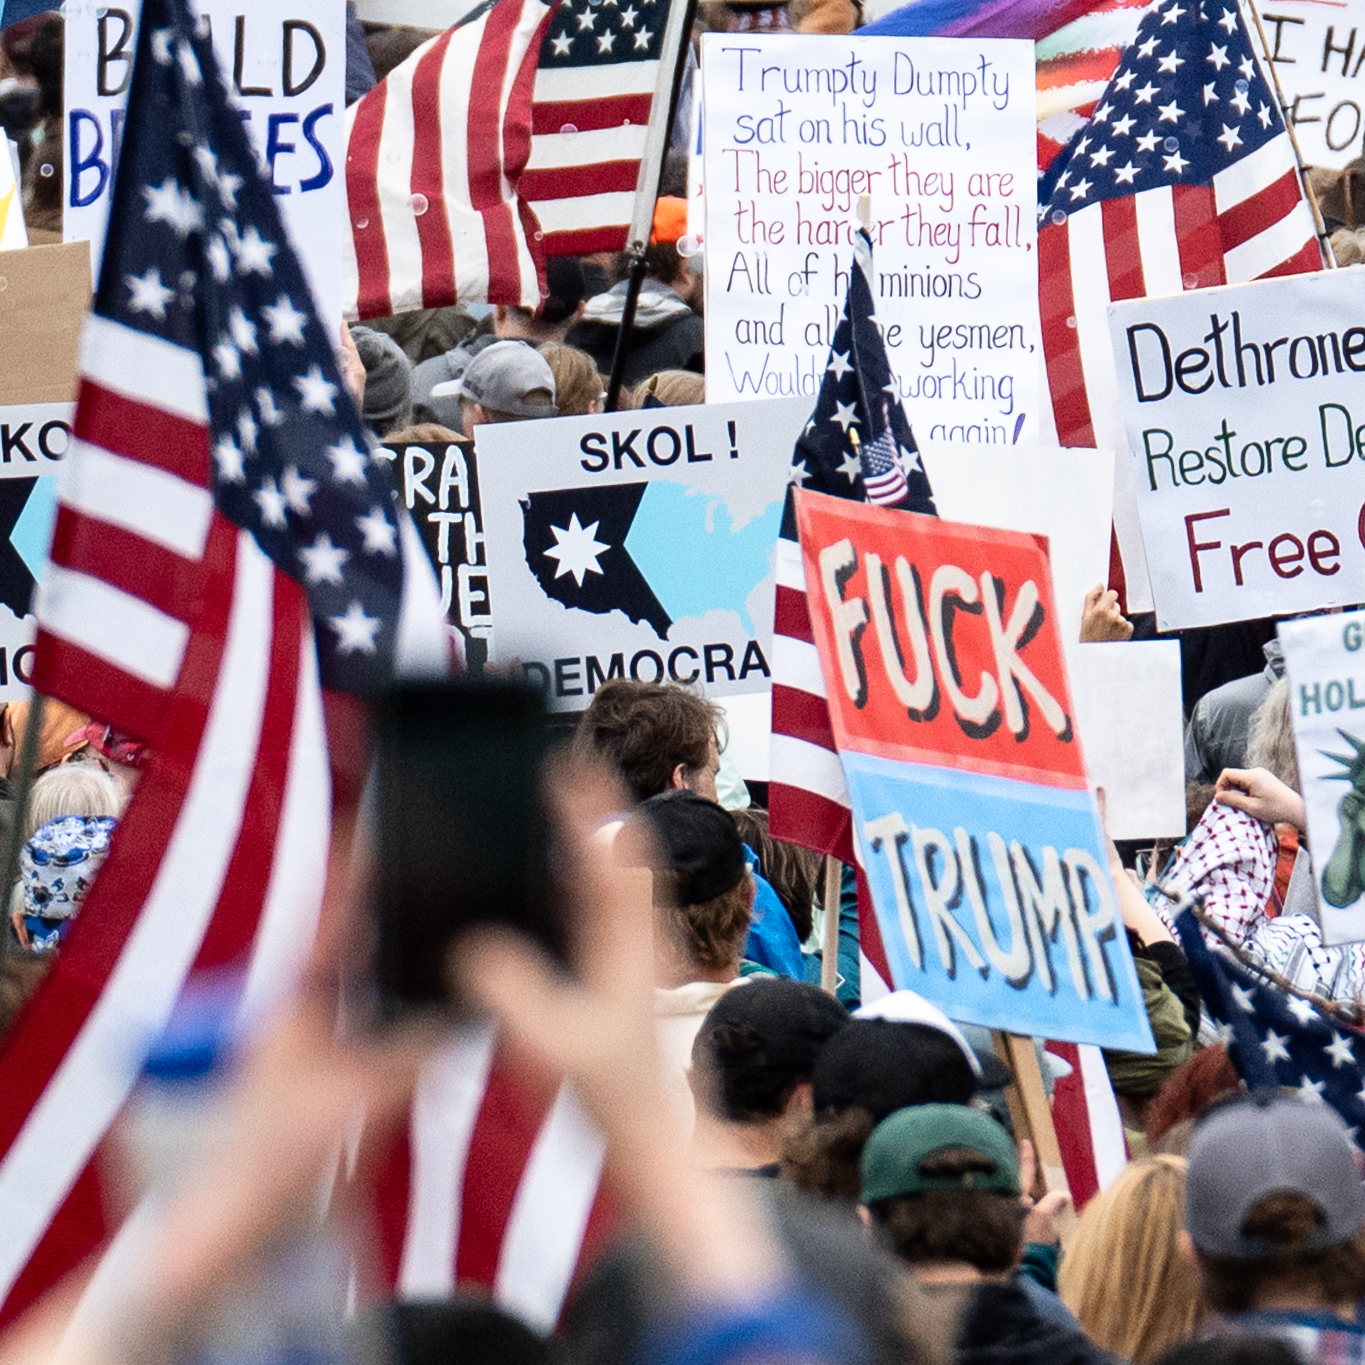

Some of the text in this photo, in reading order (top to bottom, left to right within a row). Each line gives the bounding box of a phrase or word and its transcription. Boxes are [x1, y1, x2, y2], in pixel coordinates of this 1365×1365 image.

[97, 8, 327, 98] BLD
[1262, 13, 1306, 64] I
[722, 47, 1010, 110] Trumpty Dumpty
[733, 99, 971, 151] sat on his wall,
[722, 148, 1014, 213] The bigger they are
[734, 200, 1032, 264] the they fall,
[727, 252, 771, 295] All
[787, 252, 818, 296] of
[879, 265, 982, 299] minions
[735, 304, 784, 346] and
[919, 322, 1035, 367] yesmen,
[899, 357, 1014, 414] working
[580, 425, 713, 474] SKOL
[1142, 418, 1308, 492] Restore
[1184, 508, 1341, 593] Free
[818, 537, 1074, 743] FUCK
[863, 811, 1119, 1005] TRUMP
